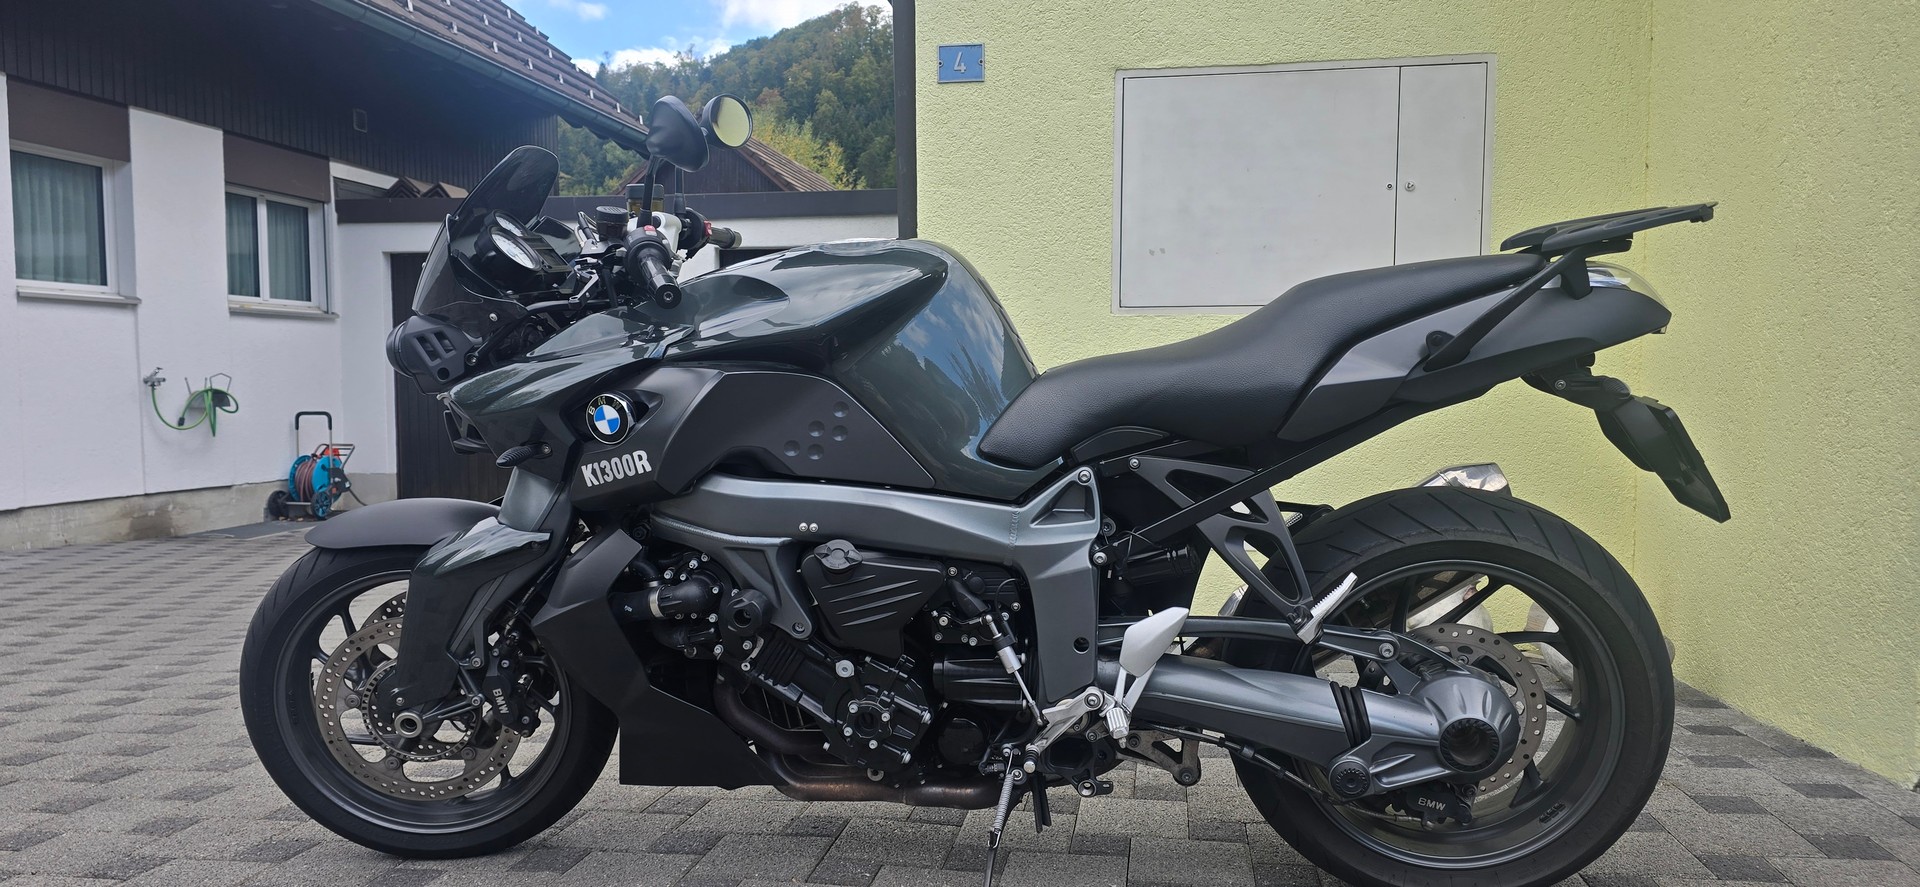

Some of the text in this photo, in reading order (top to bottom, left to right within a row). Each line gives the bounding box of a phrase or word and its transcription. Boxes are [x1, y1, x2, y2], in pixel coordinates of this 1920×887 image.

[953, 51, 967, 73] 4
[587, 396, 621, 415] BMW
[581, 450, 652, 487] K1300R
[492, 688, 509, 714] BMW
[1418, 797, 1446, 811] BMW
